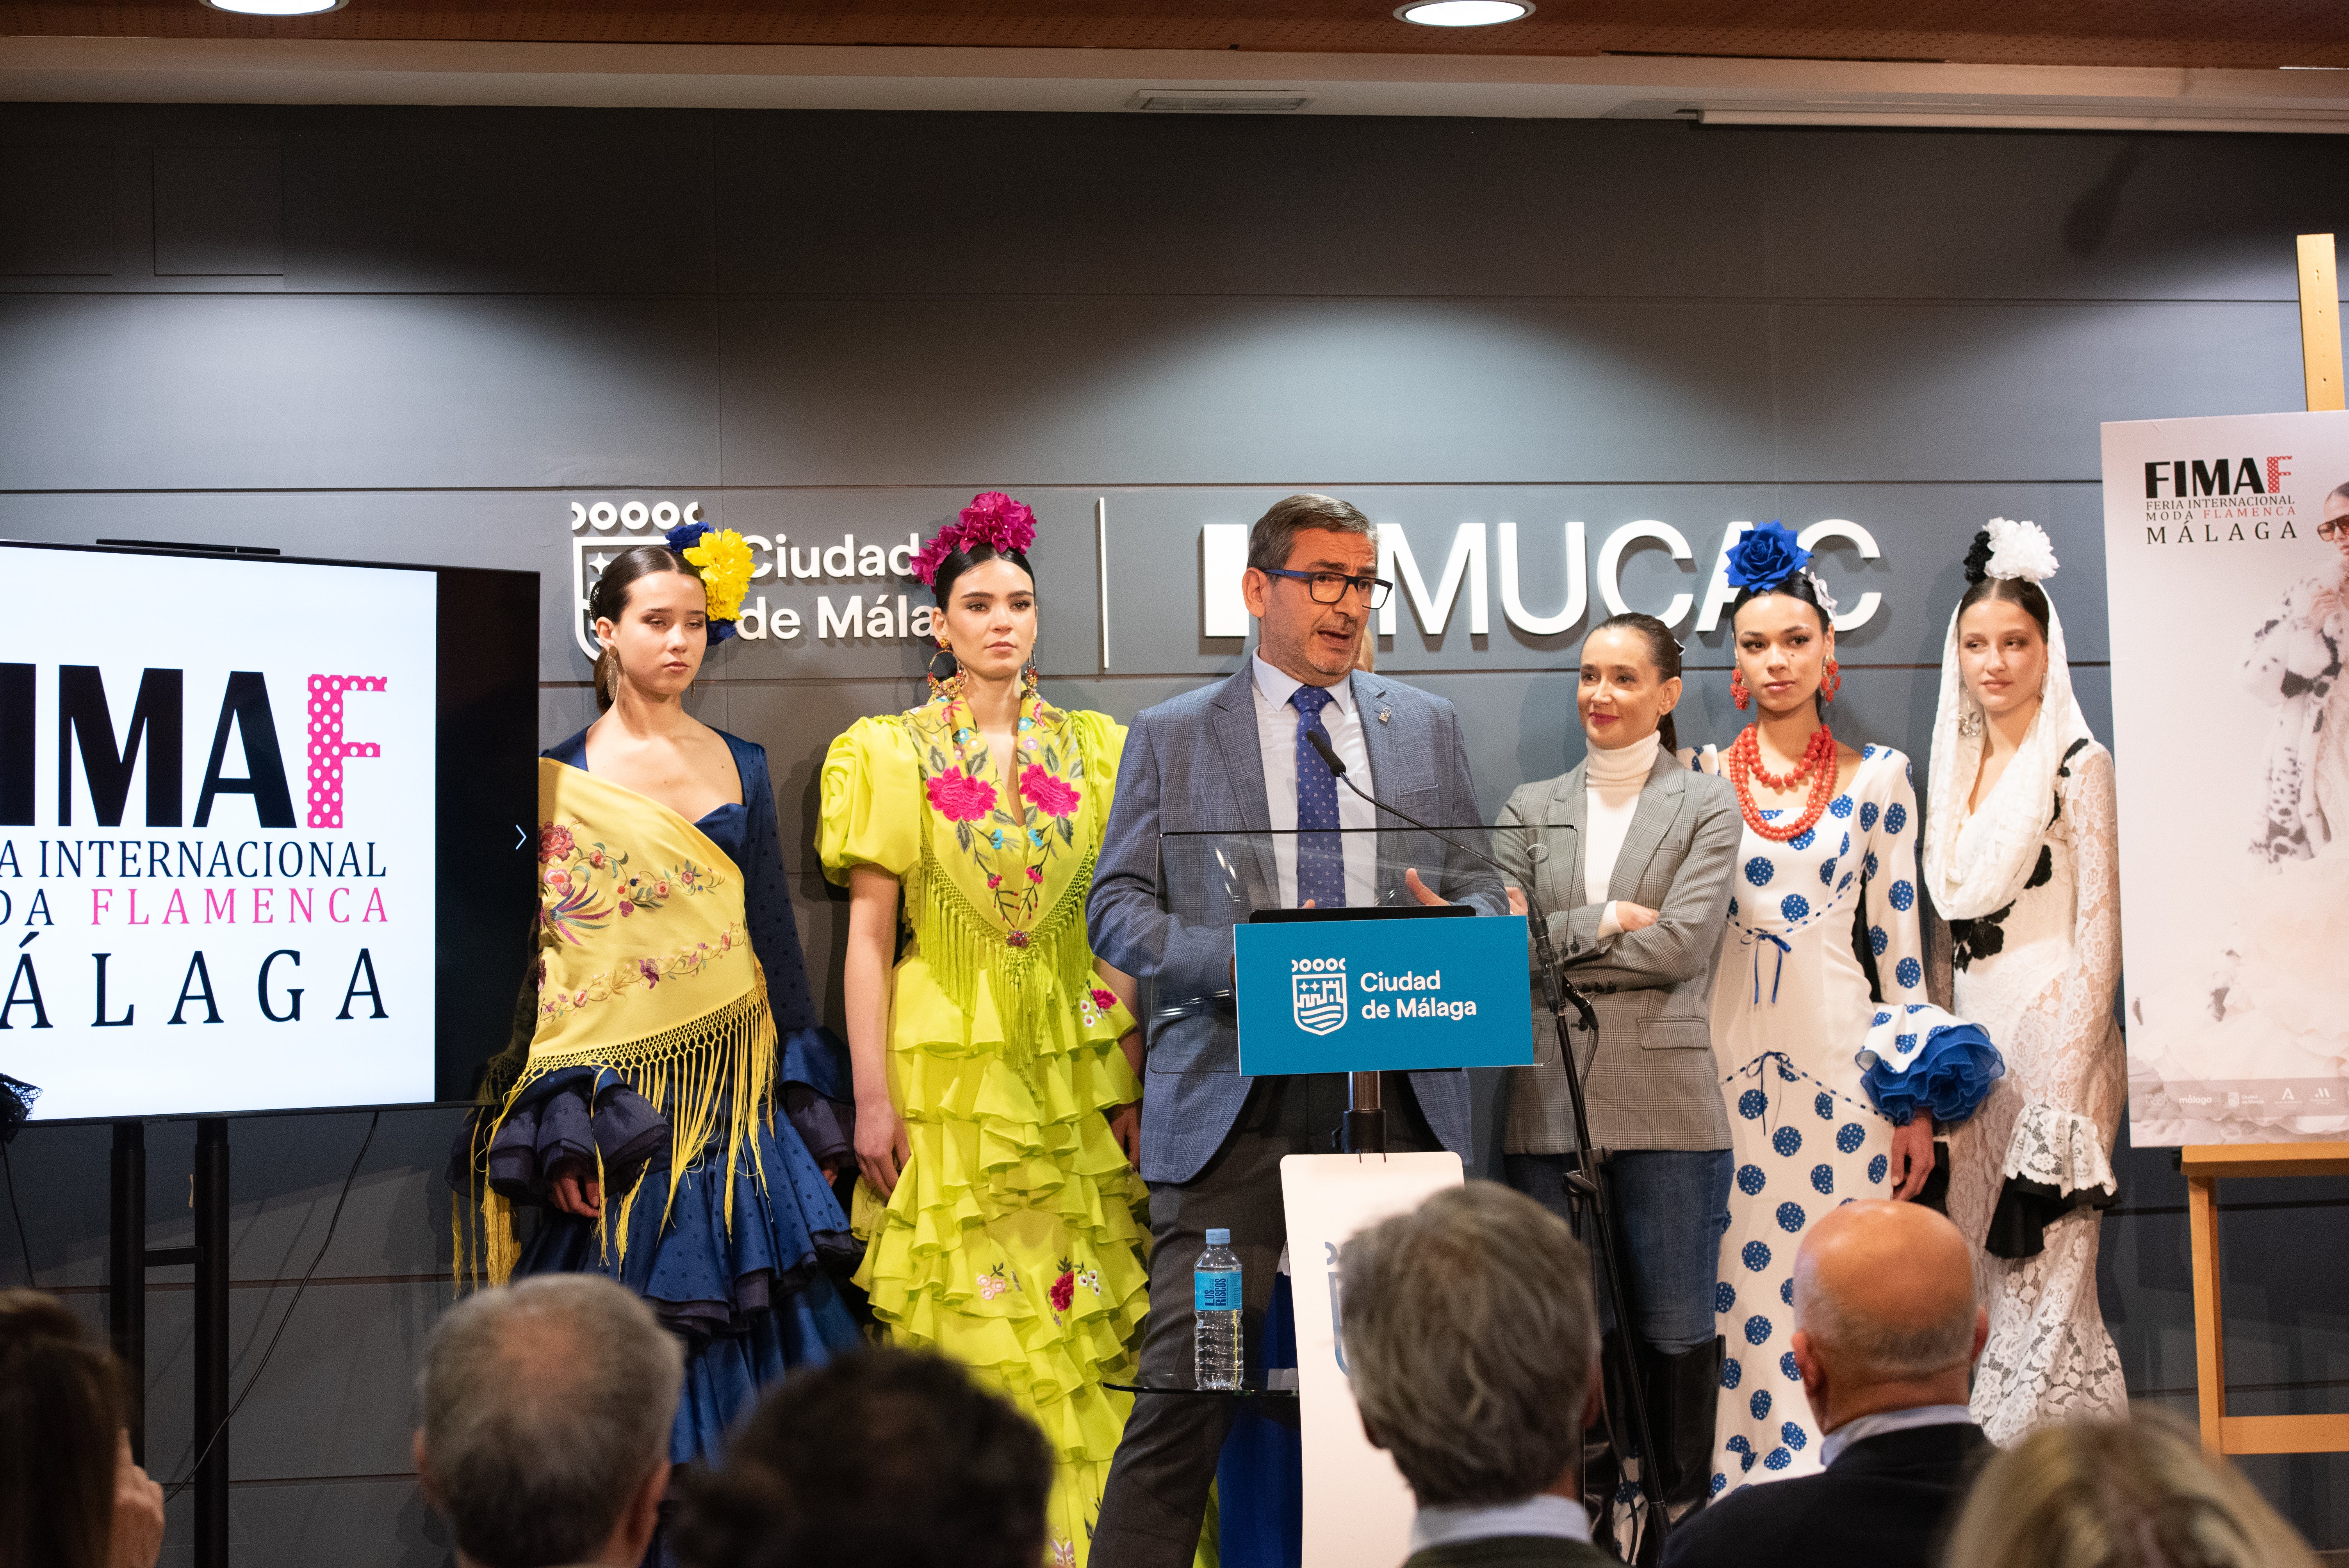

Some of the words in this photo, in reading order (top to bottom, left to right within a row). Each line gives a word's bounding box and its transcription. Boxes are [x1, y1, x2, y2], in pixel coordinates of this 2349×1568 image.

[2145, 456, 2292, 499] FIMAF
[2146, 500, 2184, 511] FERIA
[2188, 495, 2295, 509] INTERNACIONAL
[2146, 510, 2193, 521] MODA
[2203, 506, 2296, 519] FLAMENCA
[2147, 520, 2297, 544] MÁLAGA
[741, 533, 920, 578] Ciudad
[736, 597, 800, 640] de
[817, 594, 936, 639] Mála
[0, 662, 388, 829] IMAF
[39, 840, 387, 878] INTERNACIONAL
[91, 887, 389, 926] FLAMENCA
[0, 931, 389, 1029] ÁLAGA
[1360, 970, 1440, 992] Ciudad
[1362, 1000, 1390, 1019] de
[1397, 997, 1477, 1021] Málaga
[1204, 1290, 1215, 1306] LOS
[1215, 1278, 1226, 1306] RISCOS
